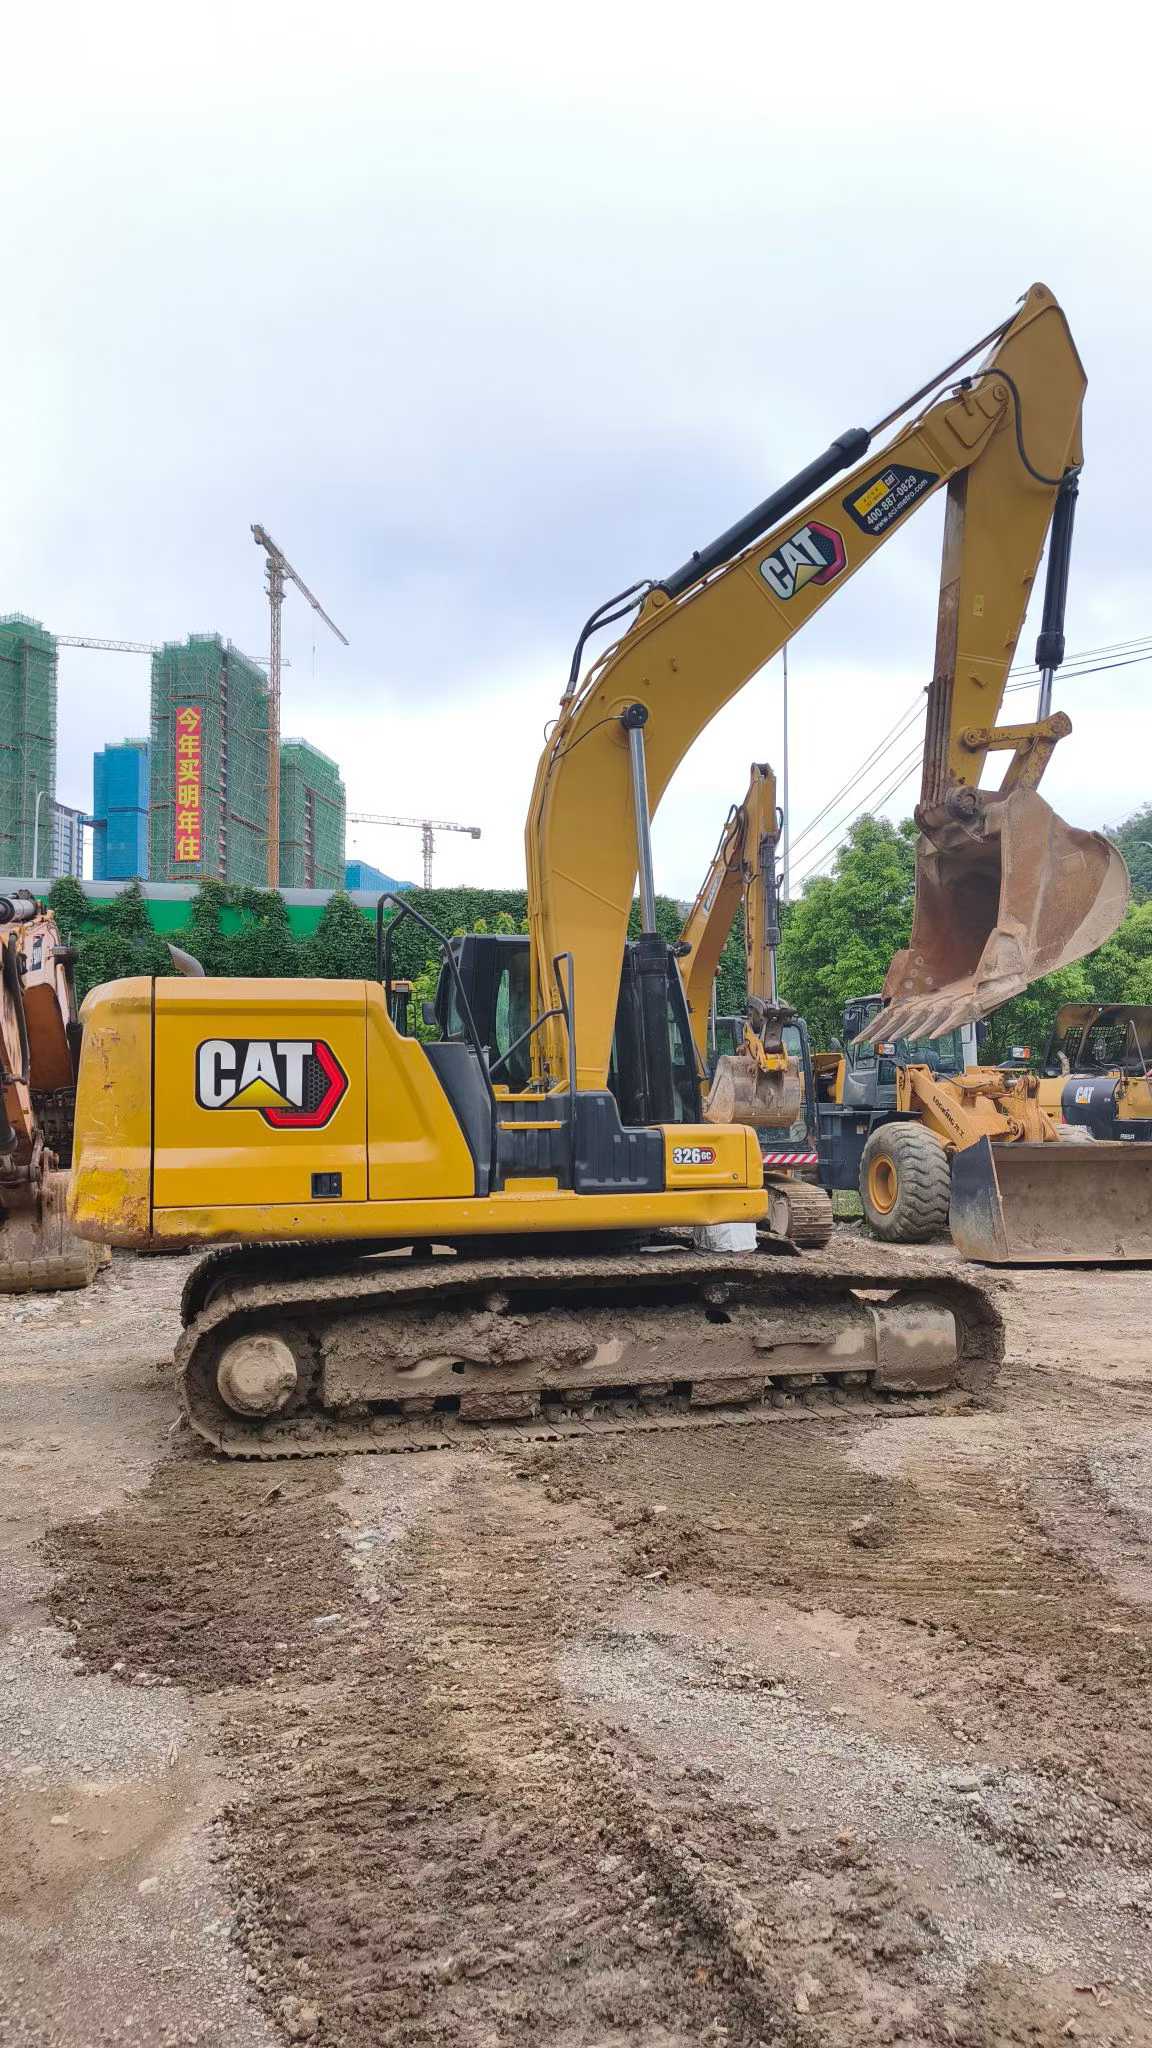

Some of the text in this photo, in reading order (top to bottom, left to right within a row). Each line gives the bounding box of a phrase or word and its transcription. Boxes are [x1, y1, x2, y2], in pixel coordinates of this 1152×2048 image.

[867, 475, 917, 525] 400-887-0829
[760, 526, 828, 600] CAT
[177, 707, 201, 861] 今年买明年住
[199, 1039, 313, 1108] CAT
[1075, 1086, 1095, 1105] CAT
[673, 1147, 712, 1164] 326 GC
